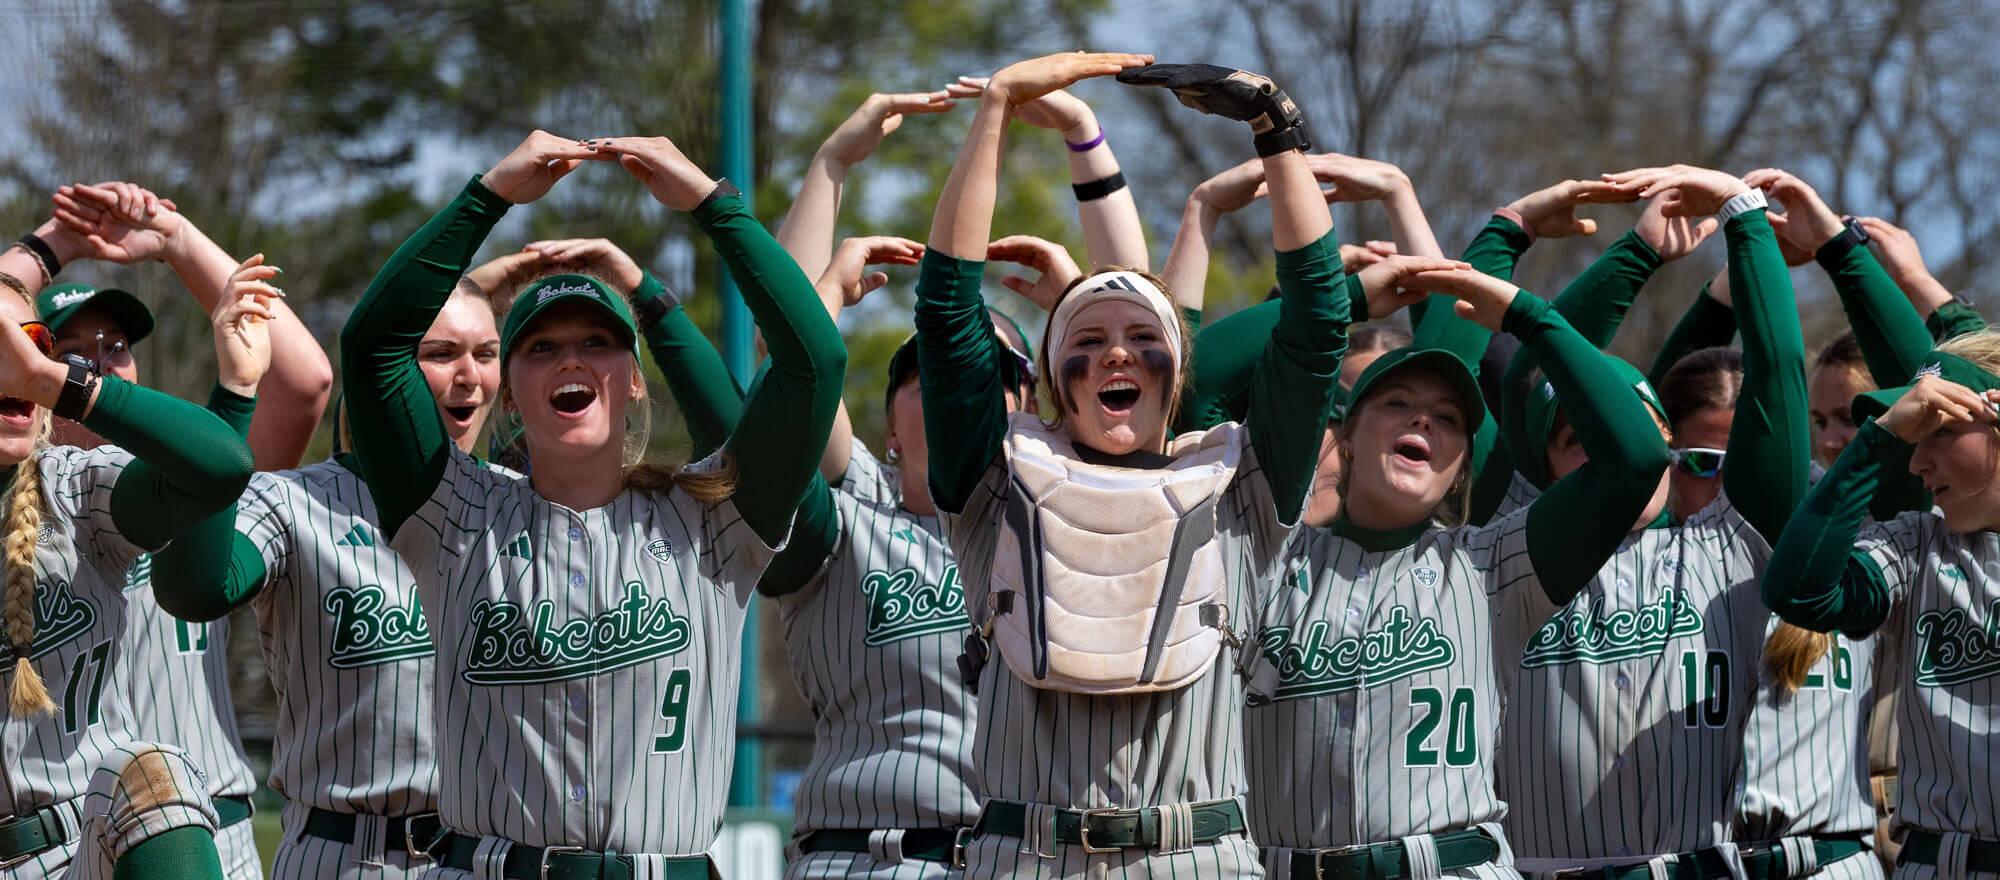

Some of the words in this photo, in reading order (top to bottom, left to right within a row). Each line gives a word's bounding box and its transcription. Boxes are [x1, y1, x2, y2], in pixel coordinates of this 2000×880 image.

[536, 281, 600, 305] Bobcats
[462, 581, 691, 686] Bobcats
[1246, 604, 1456, 706] Bobcats
[63, 638, 115, 736] 11
[651, 668, 692, 754] 9
[1404, 684, 1478, 768] 20
[1679, 650, 1740, 729] 10
